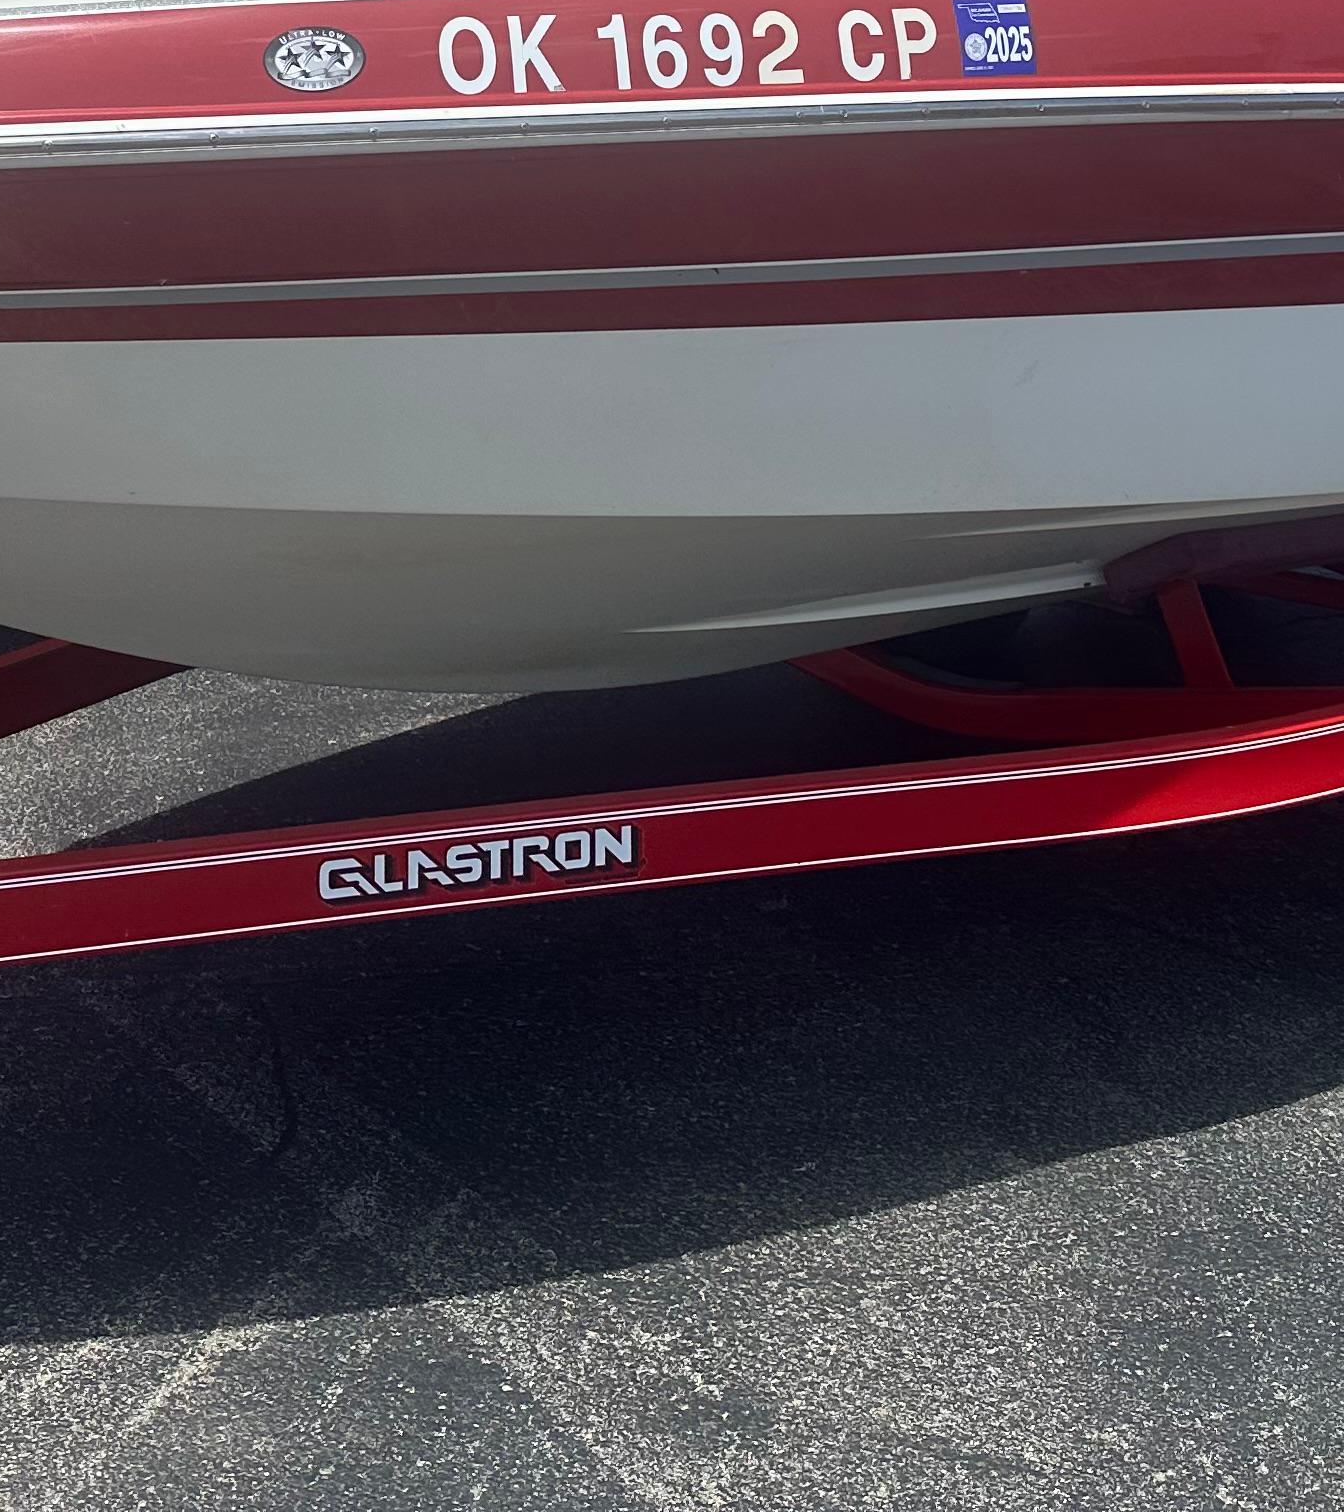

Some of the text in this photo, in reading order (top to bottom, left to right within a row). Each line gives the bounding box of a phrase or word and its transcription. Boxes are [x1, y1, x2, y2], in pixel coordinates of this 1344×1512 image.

[278, 29, 346, 46] ULTRA LOW
[438, 7, 937, 96] OK 1692 CP
[984, 25, 1033, 63] 2025
[317, 824, 633, 901] GLASTRON
